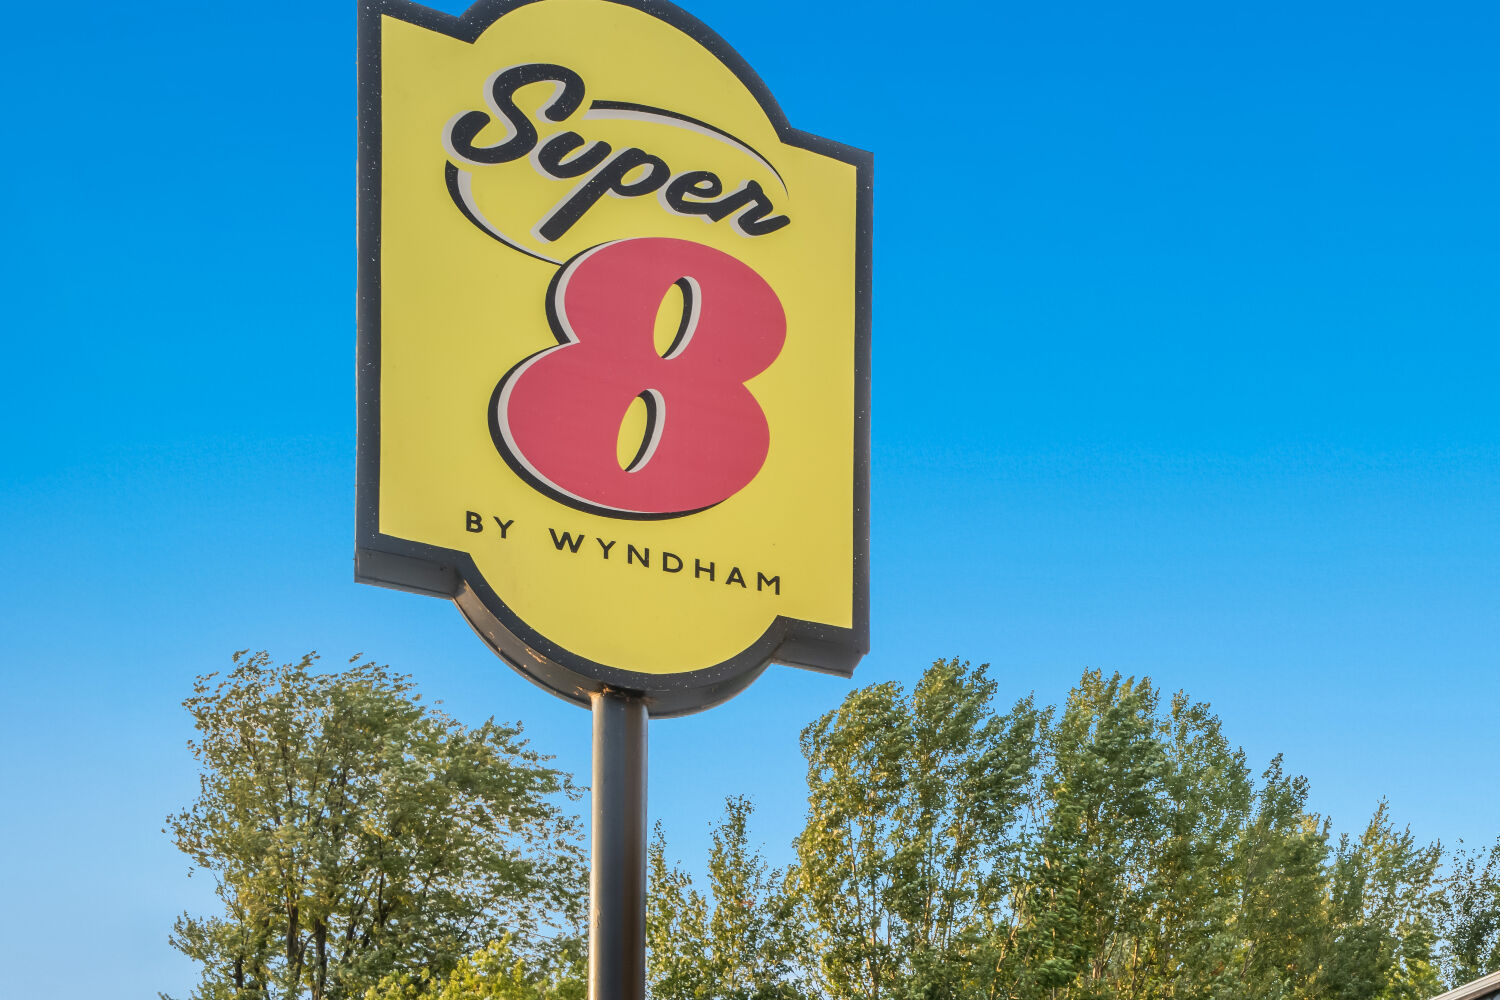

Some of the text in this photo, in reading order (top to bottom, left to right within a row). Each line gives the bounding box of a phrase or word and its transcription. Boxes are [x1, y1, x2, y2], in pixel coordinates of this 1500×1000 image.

[442, 63, 791, 242] Super
[487, 236, 788, 521] 8
[465, 510, 782, 596] BY WYNDHAM
